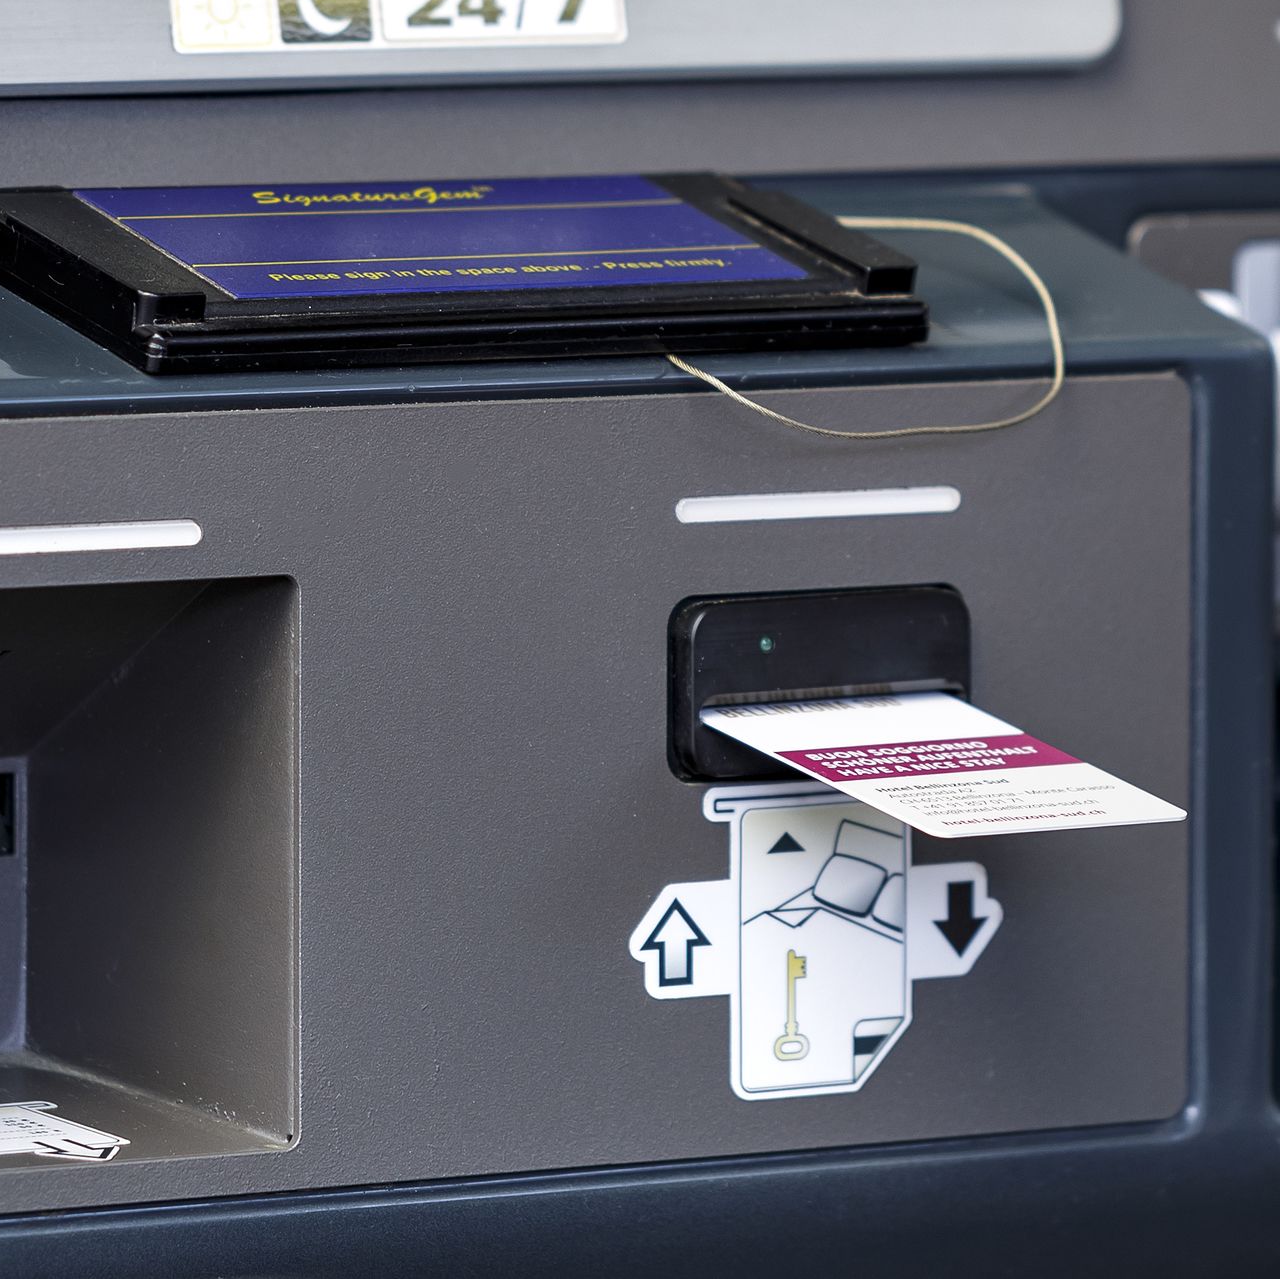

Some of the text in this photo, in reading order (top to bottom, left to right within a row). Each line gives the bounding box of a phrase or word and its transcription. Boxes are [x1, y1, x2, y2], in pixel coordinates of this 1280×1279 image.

[268, 272, 341, 282] Please
[345, 270, 391, 280] sign
[392, 269, 416, 278] in
[416, 268, 452, 277] the
[455, 266, 518, 276] space
[521, 263, 590, 273] above.
[602, 261, 664, 270] Press
[805, 741, 988, 761] BUON SOGGIORNO
[821, 746, 1039, 769] SCHÖNER AUFENTHALT
[836, 757, 1007, 777] HAVE A NICE STAY
[875, 785, 914, 793] Hotel
[914, 781, 983, 789] Bellinzona
[941, 809, 1107, 826] hotel-bellinzona-sud.ch
